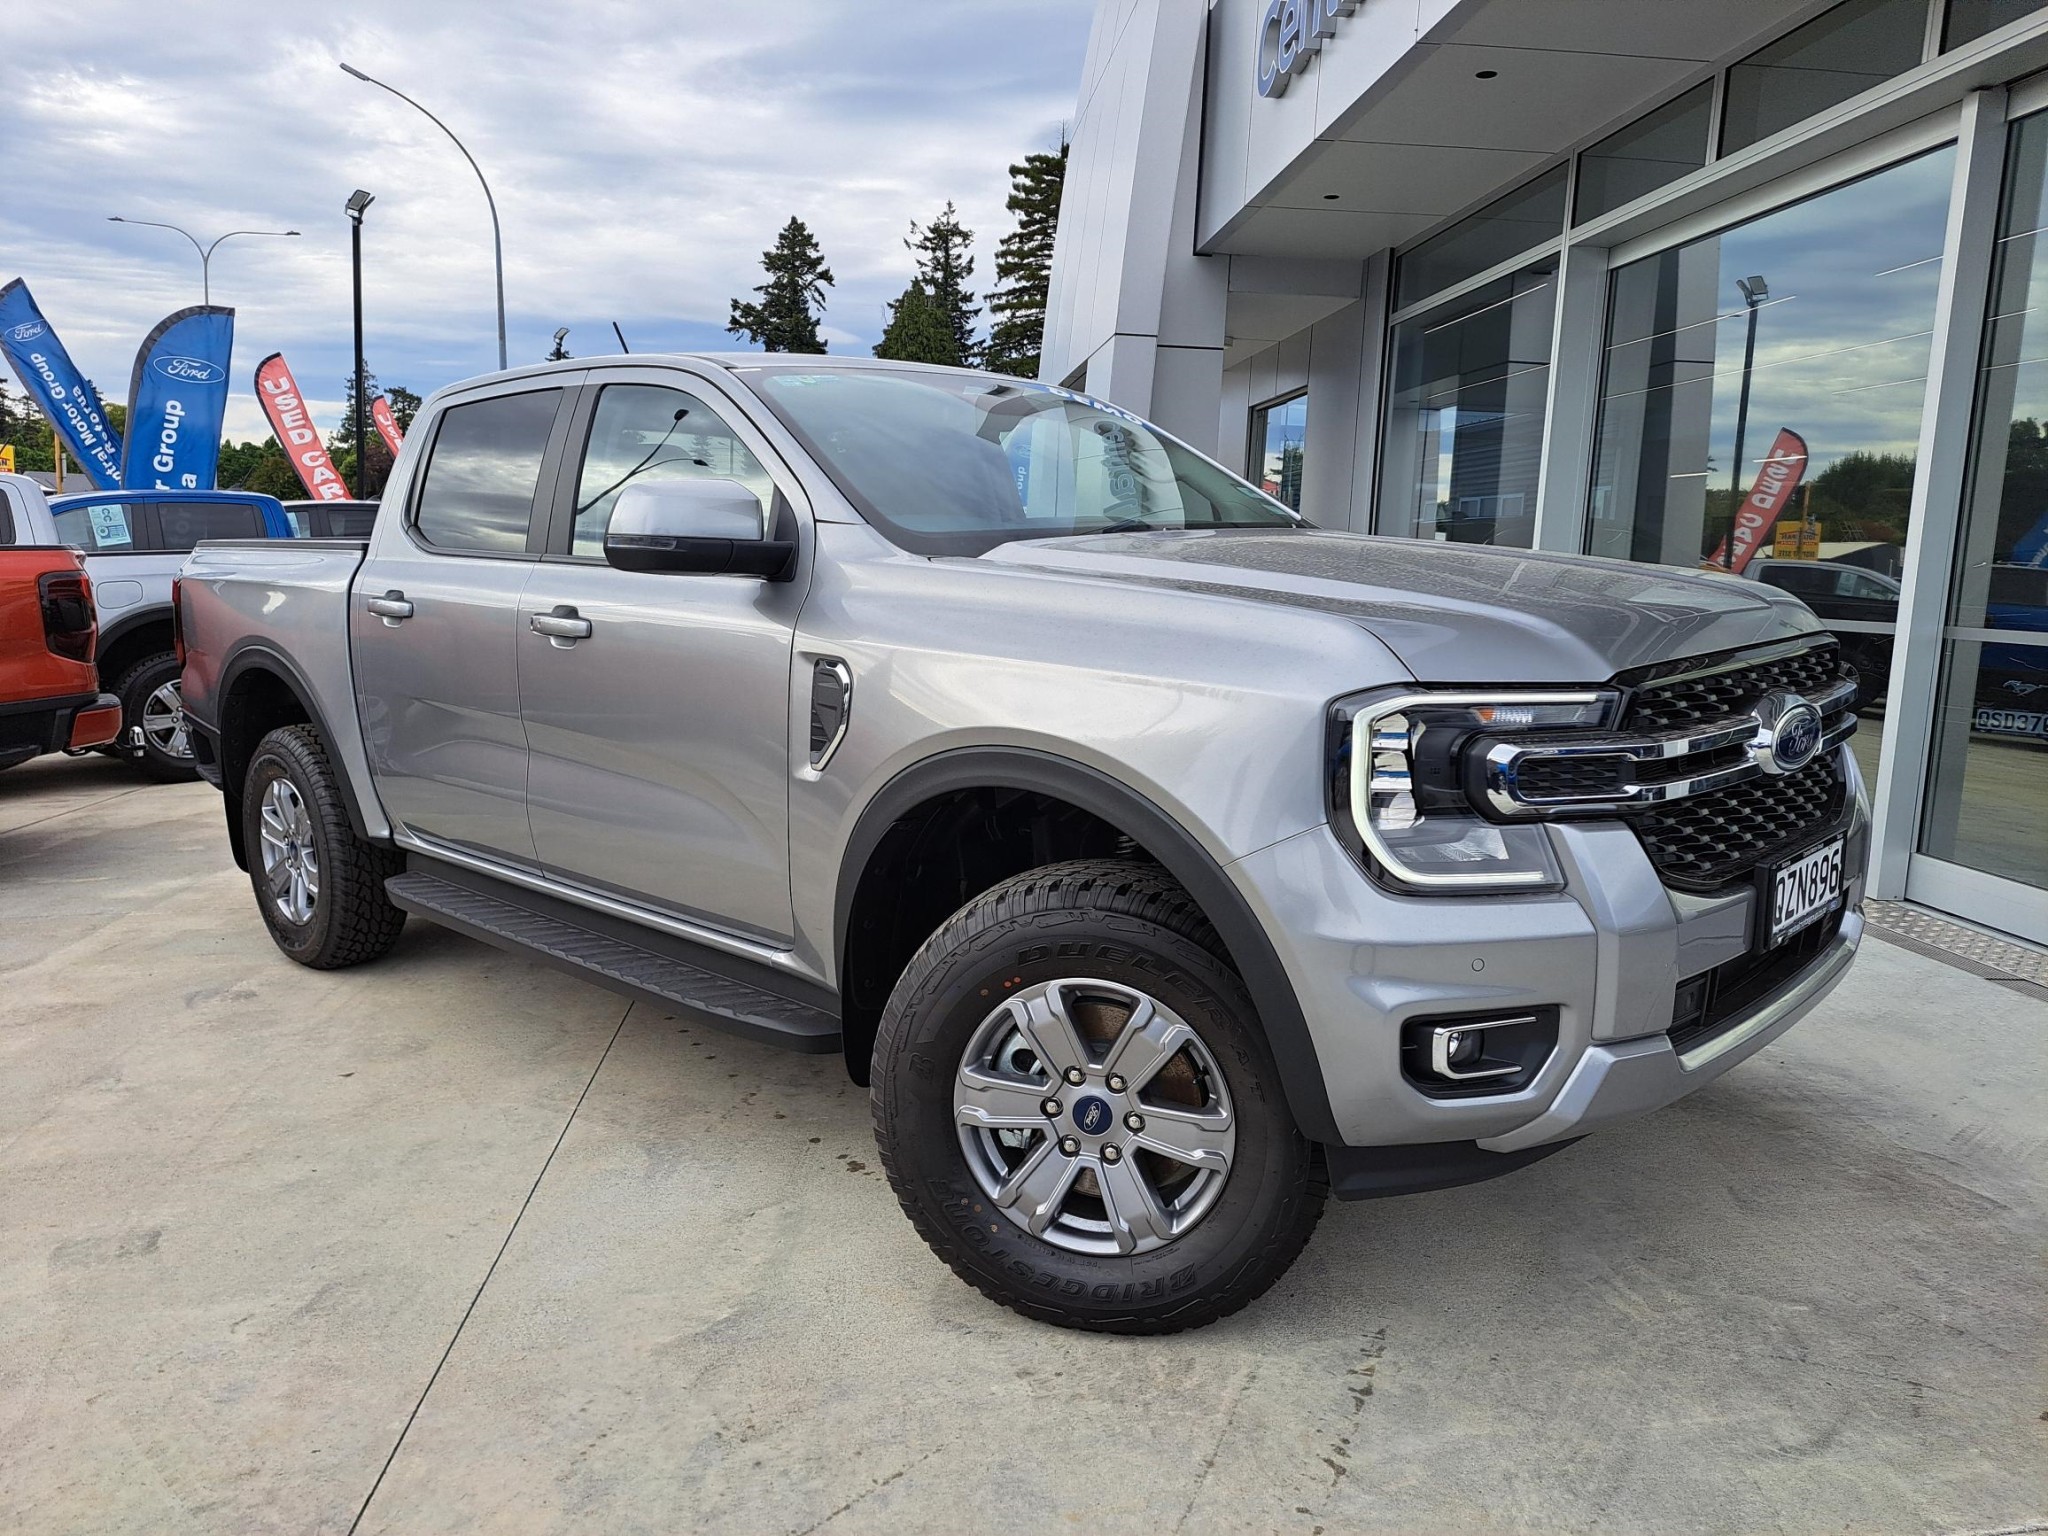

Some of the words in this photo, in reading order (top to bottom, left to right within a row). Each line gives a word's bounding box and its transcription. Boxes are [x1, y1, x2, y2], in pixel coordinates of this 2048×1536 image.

[30, 353, 66, 400] Group
[167, 359, 211, 380] Ford
[62, 403, 97, 447] Motor
[153, 400, 187, 474] Group
[263, 376, 314, 446] USED
[301, 450, 348, 500] CAR
[1773, 848, 1840, 927] QZN896
[1016, 941, 1233, 1030] DUELER
[927, 1179, 1199, 1304] BRIDGESTONE
